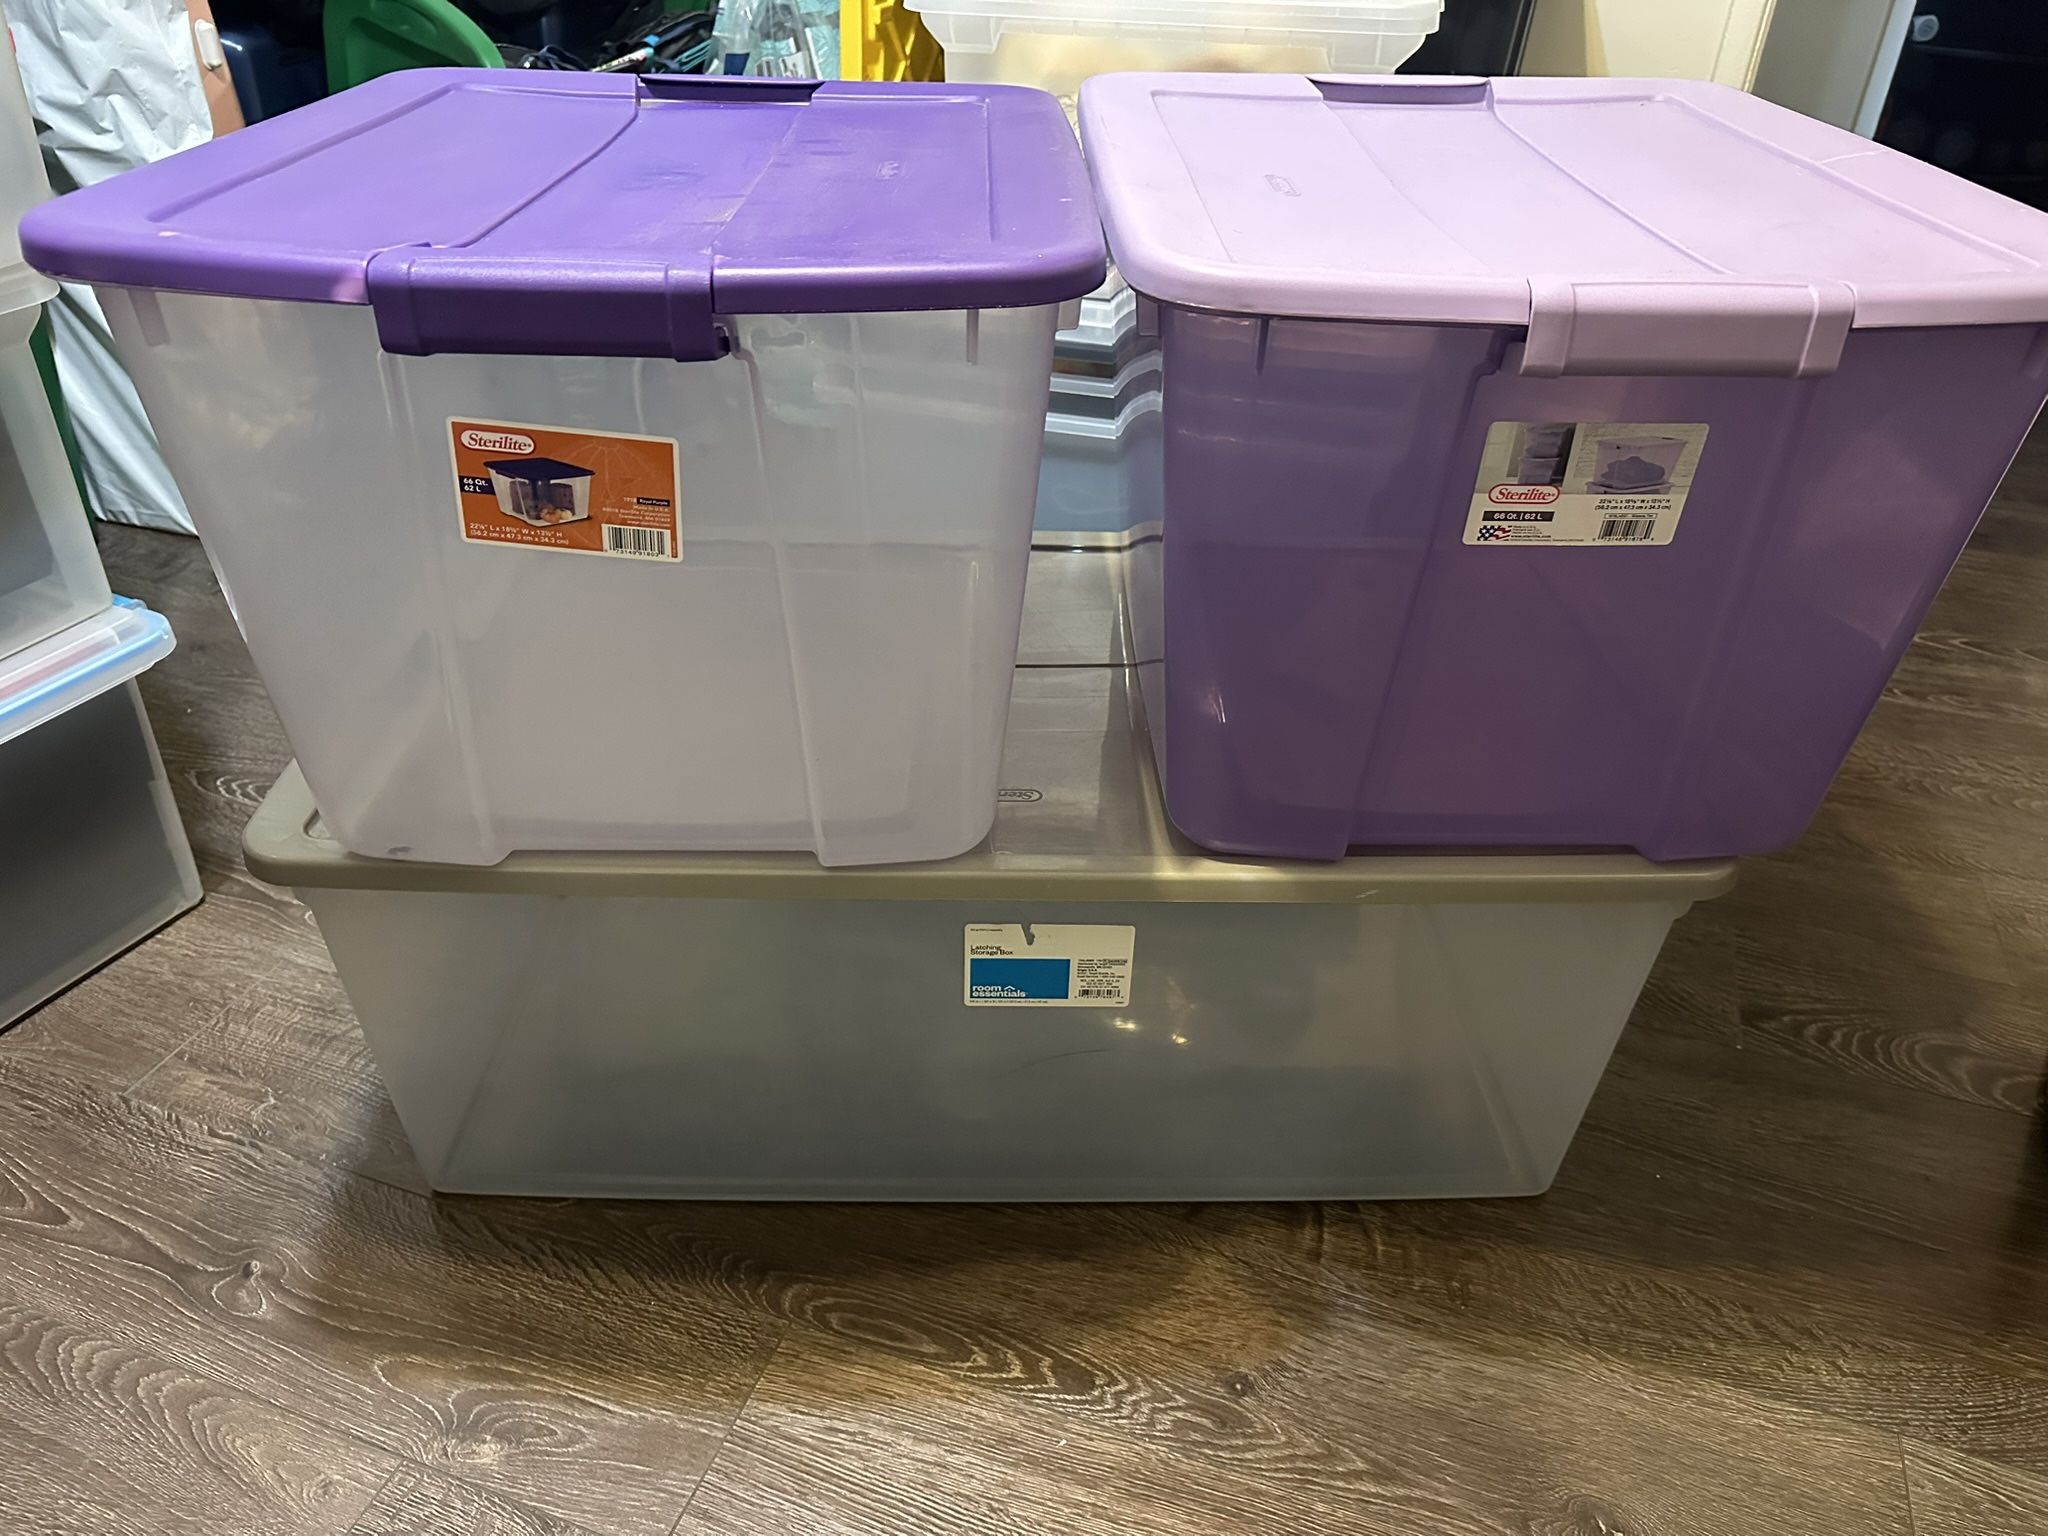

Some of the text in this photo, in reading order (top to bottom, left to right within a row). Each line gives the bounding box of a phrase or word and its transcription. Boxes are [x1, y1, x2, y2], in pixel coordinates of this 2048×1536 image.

[468, 433, 527, 451] Sterilite
[1496, 488, 1552, 500] Sterilite
[972, 989, 1026, 998] essentials
